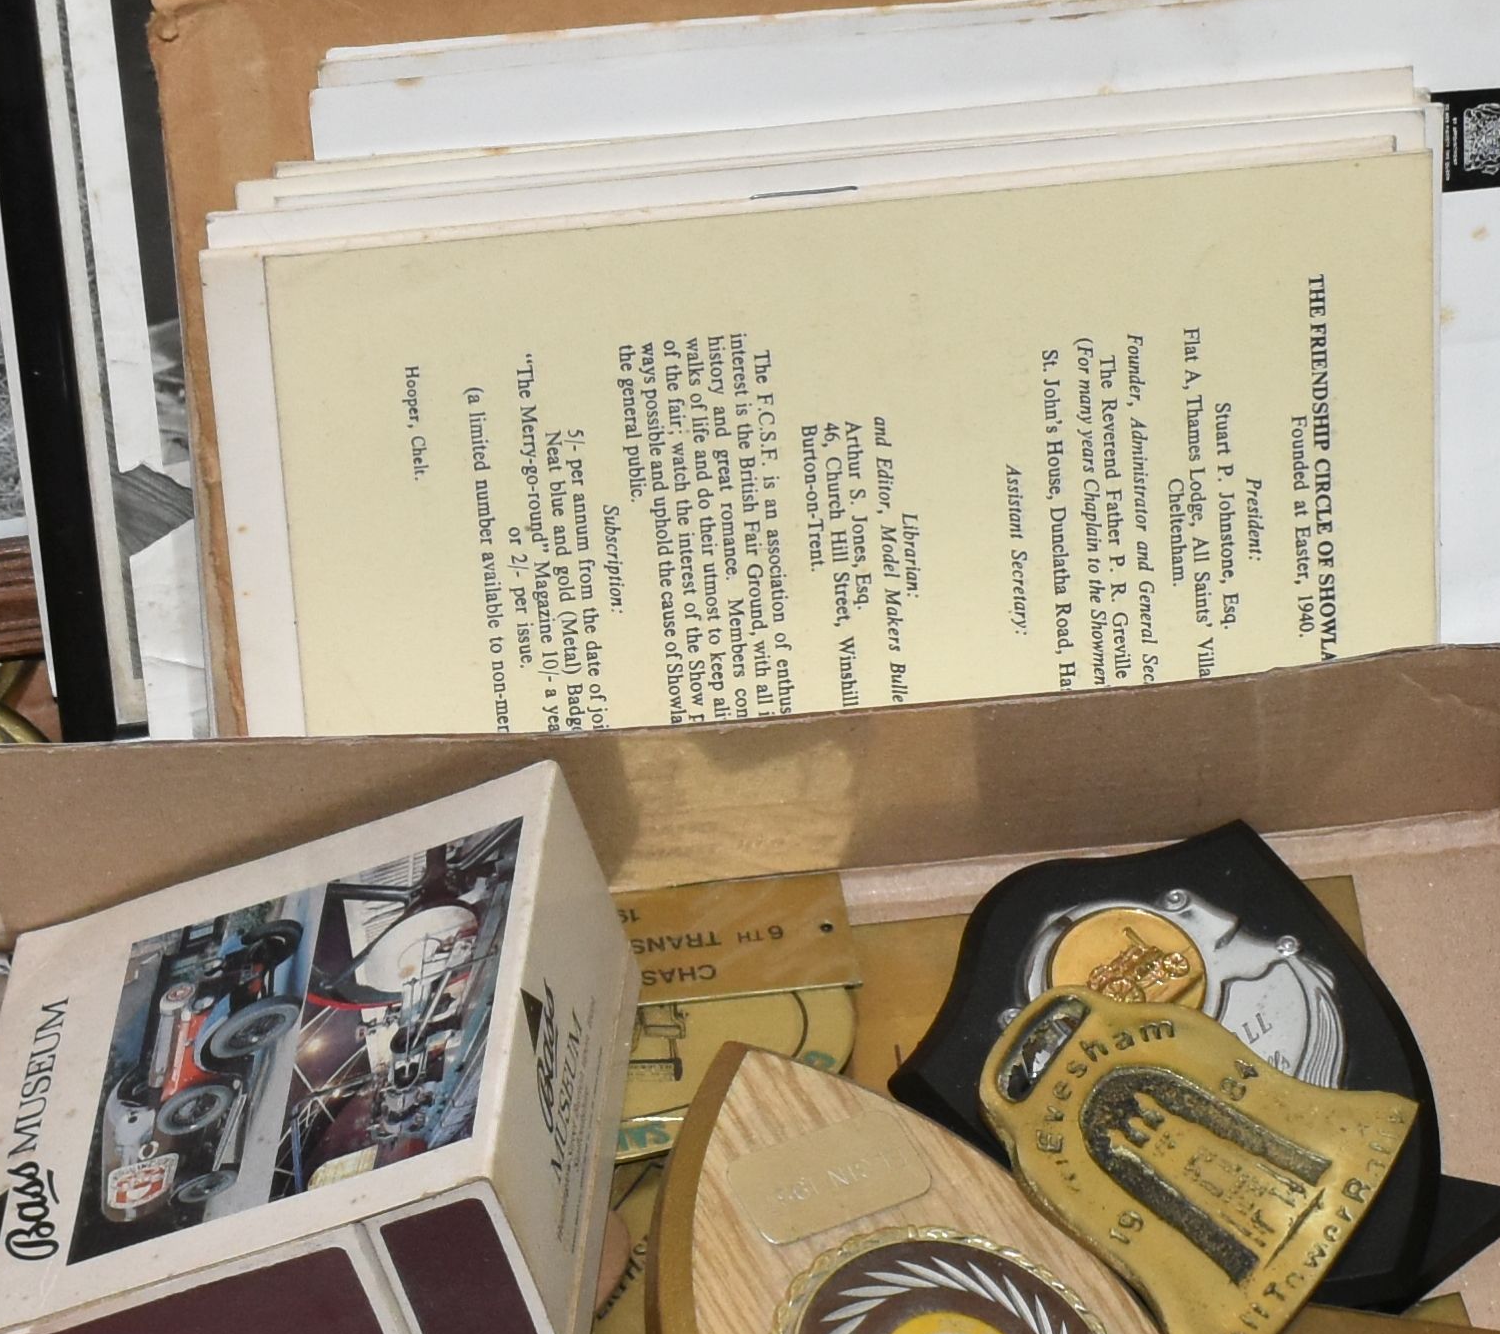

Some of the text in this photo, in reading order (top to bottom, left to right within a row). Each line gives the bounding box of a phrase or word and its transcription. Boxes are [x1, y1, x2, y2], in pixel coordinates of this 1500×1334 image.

[1041, 349, 1070, 654] St. John's House, Dunclatha Road,
[1099, 355, 1129, 678] The Reverend Father P. R. Greville
[1125, 334, 1154, 643] Founder, Administrator and General
[1167, 479, 1185, 587] Cheltenham.
[1182, 328, 1211, 627] Flat A, Thames Lodge, All Saints'
[1214, 403, 1238, 629] Stuart P. Johnstone, Esq.
[1244, 478, 1262, 561] President:
[1290, 416, 1313, 638] Founded at Easter, 1940.
[1308, 274, 1332, 568] THE FRIENDSHIP CIRCLE OF
[1005, 464, 1026, 636] Assistant Secretary:
[5, 994, 72, 1261] Bass MUSEUM
[1037, 1019, 1178, 1156] Evesham
